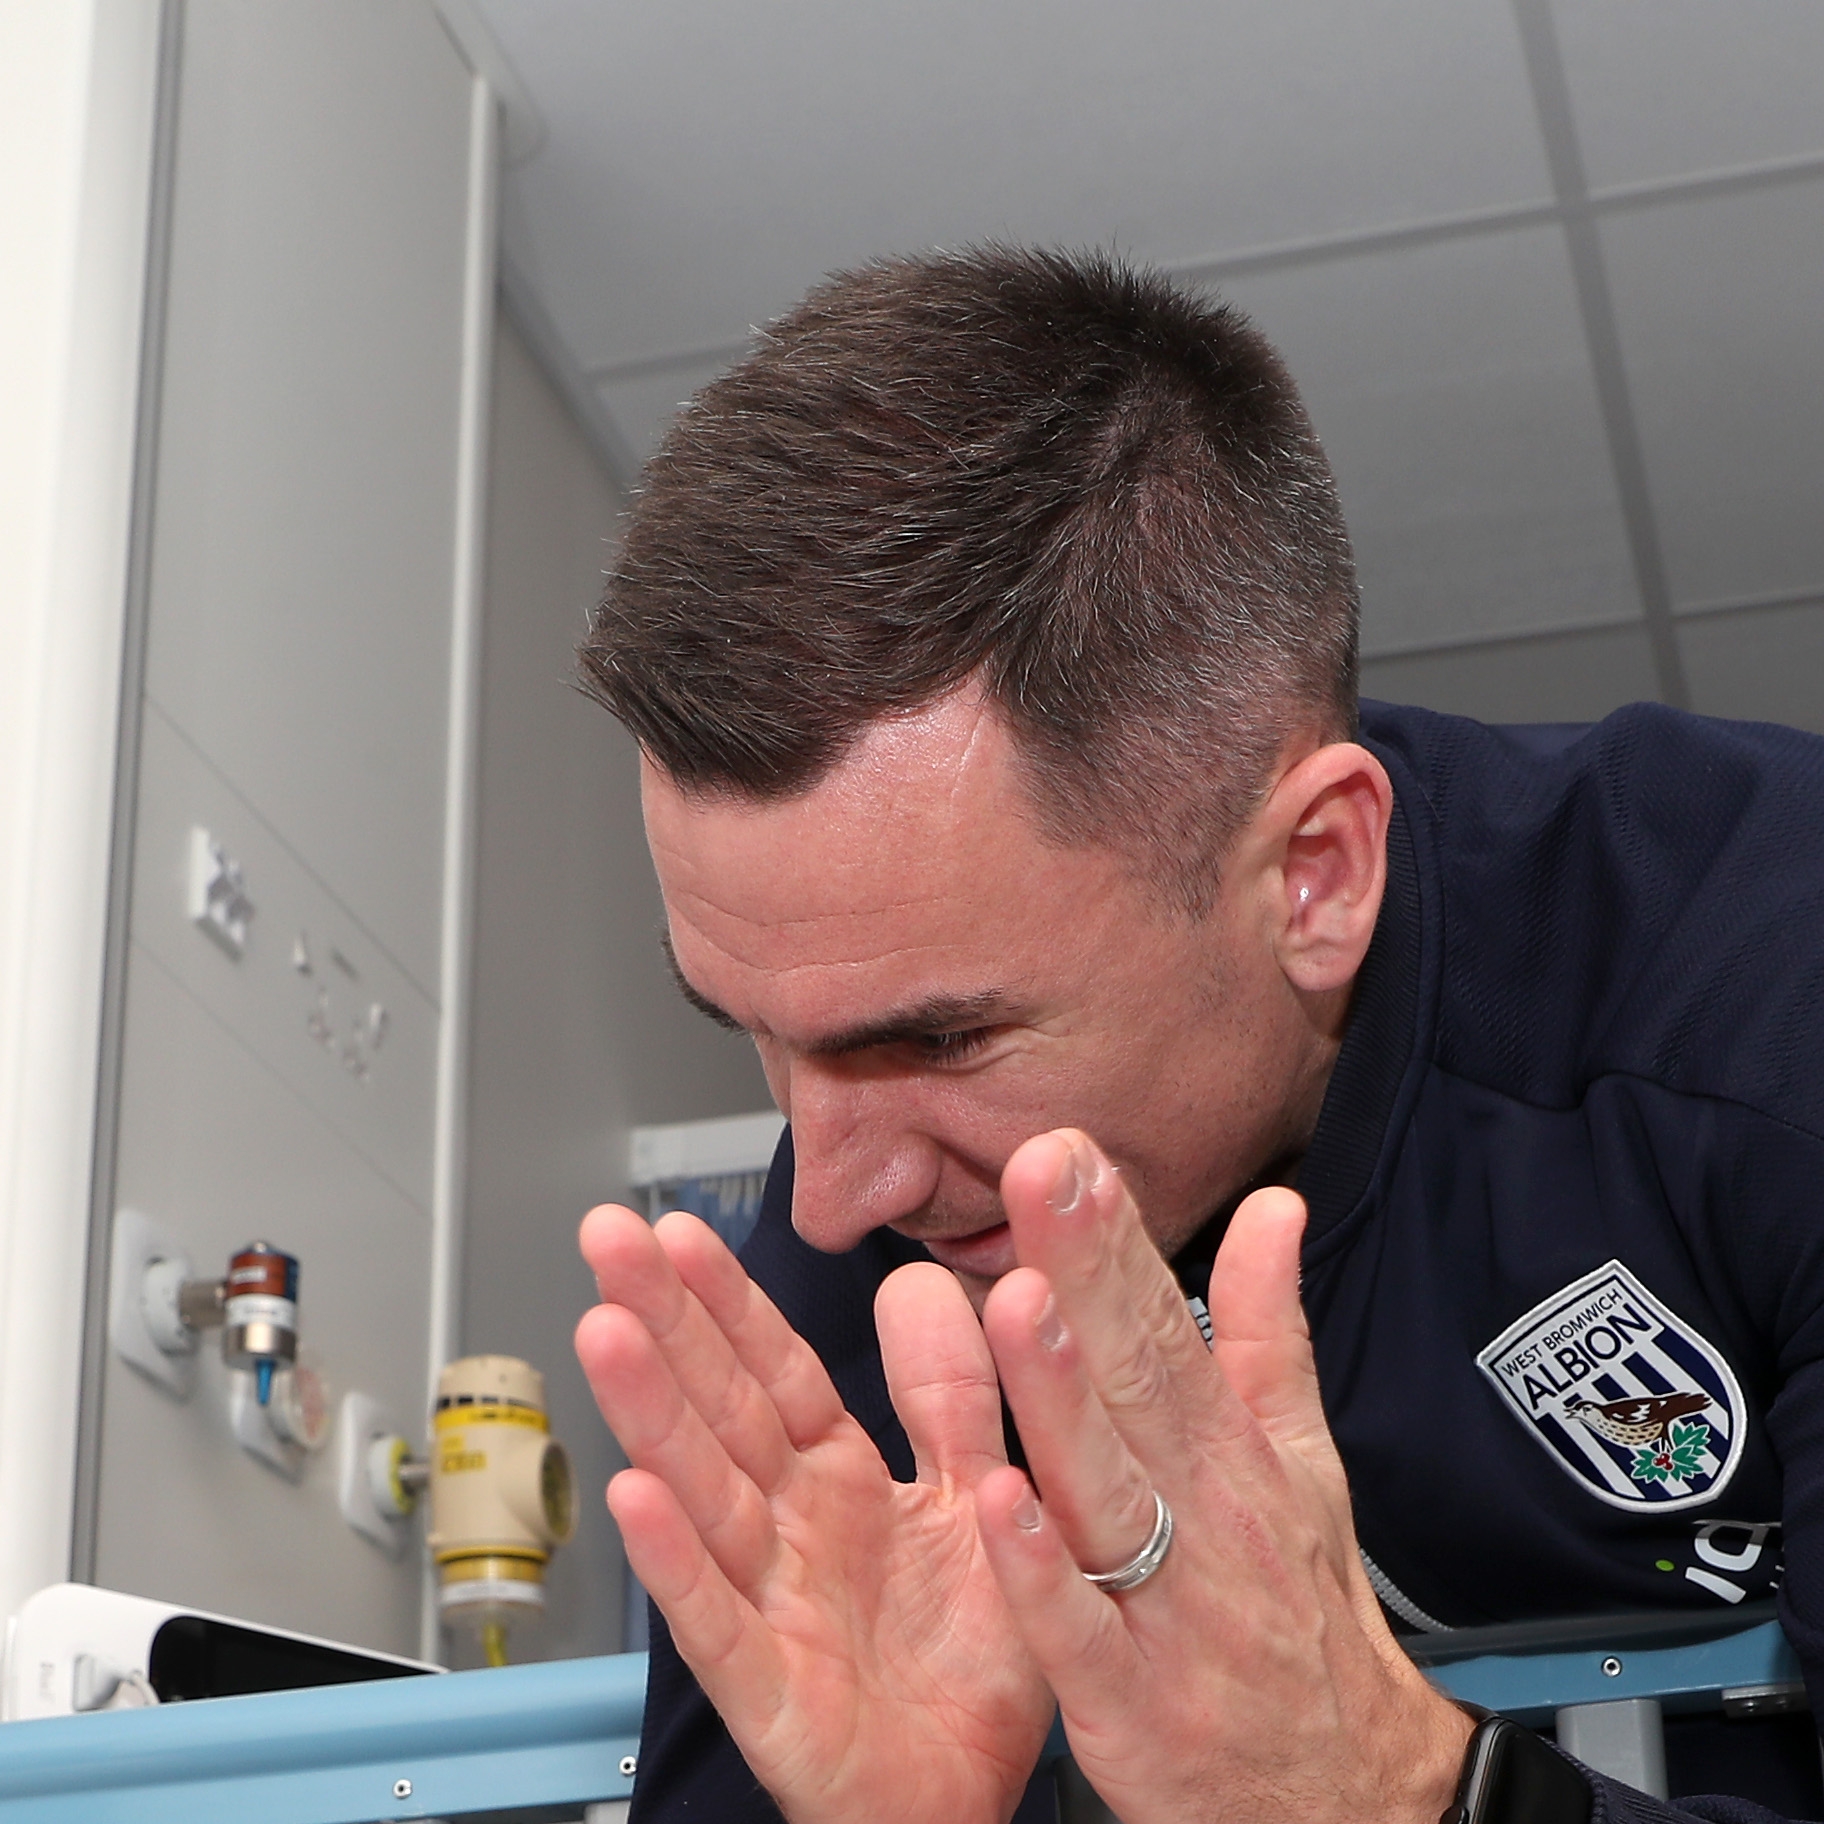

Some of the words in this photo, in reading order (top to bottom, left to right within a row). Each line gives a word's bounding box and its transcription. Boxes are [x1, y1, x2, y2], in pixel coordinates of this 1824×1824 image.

[1501, 1343, 1543, 1378] WEST
[1542, 1288, 1623, 1351] BROMWICH
[1522, 1303, 1652, 1411] ALBION
